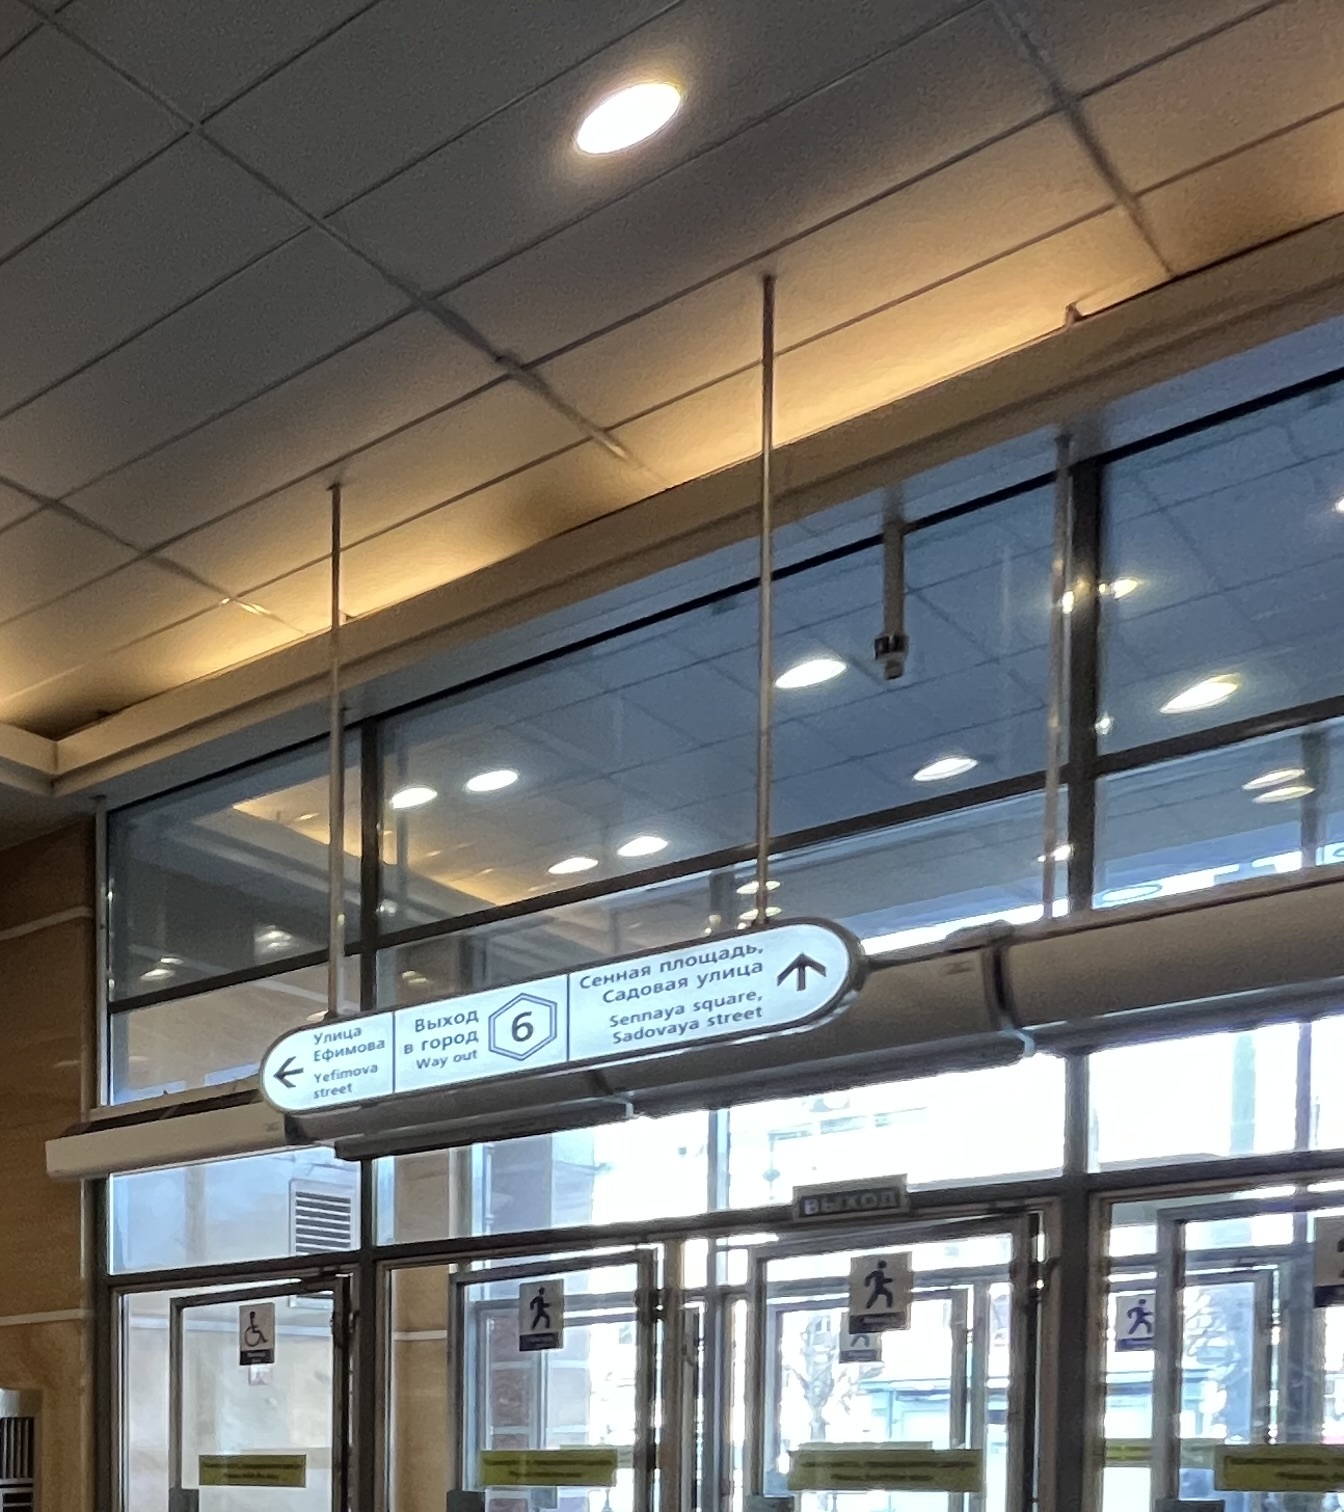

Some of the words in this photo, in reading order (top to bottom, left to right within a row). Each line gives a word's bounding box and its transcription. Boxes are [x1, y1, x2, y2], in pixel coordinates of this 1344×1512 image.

[579, 965, 651, 990] Сенная
[660, 943, 764, 973] площадь,
[602, 978, 688, 1004] Садовая
[697, 962, 764, 989] улица
[415, 1009, 479, 1033] Выход
[609, 1005, 686, 1028] Sennaya
[693, 990, 763, 1011] square,
[313, 1025, 362, 1046] Улица
[511, 1011, 534, 1042] 6
[613, 1019, 700, 1045] Sadovaya
[707, 1006, 763, 1027] street
[313, 1038, 386, 1063] Ефимова
[404, 1042, 414, 1055] в
[421, 1030, 479, 1054] город
[417, 1055, 449, 1071] Way
[453, 1049, 479, 1063] out
[314, 1063, 379, 1085] Yefimova
[313, 1082, 353, 1100] street
